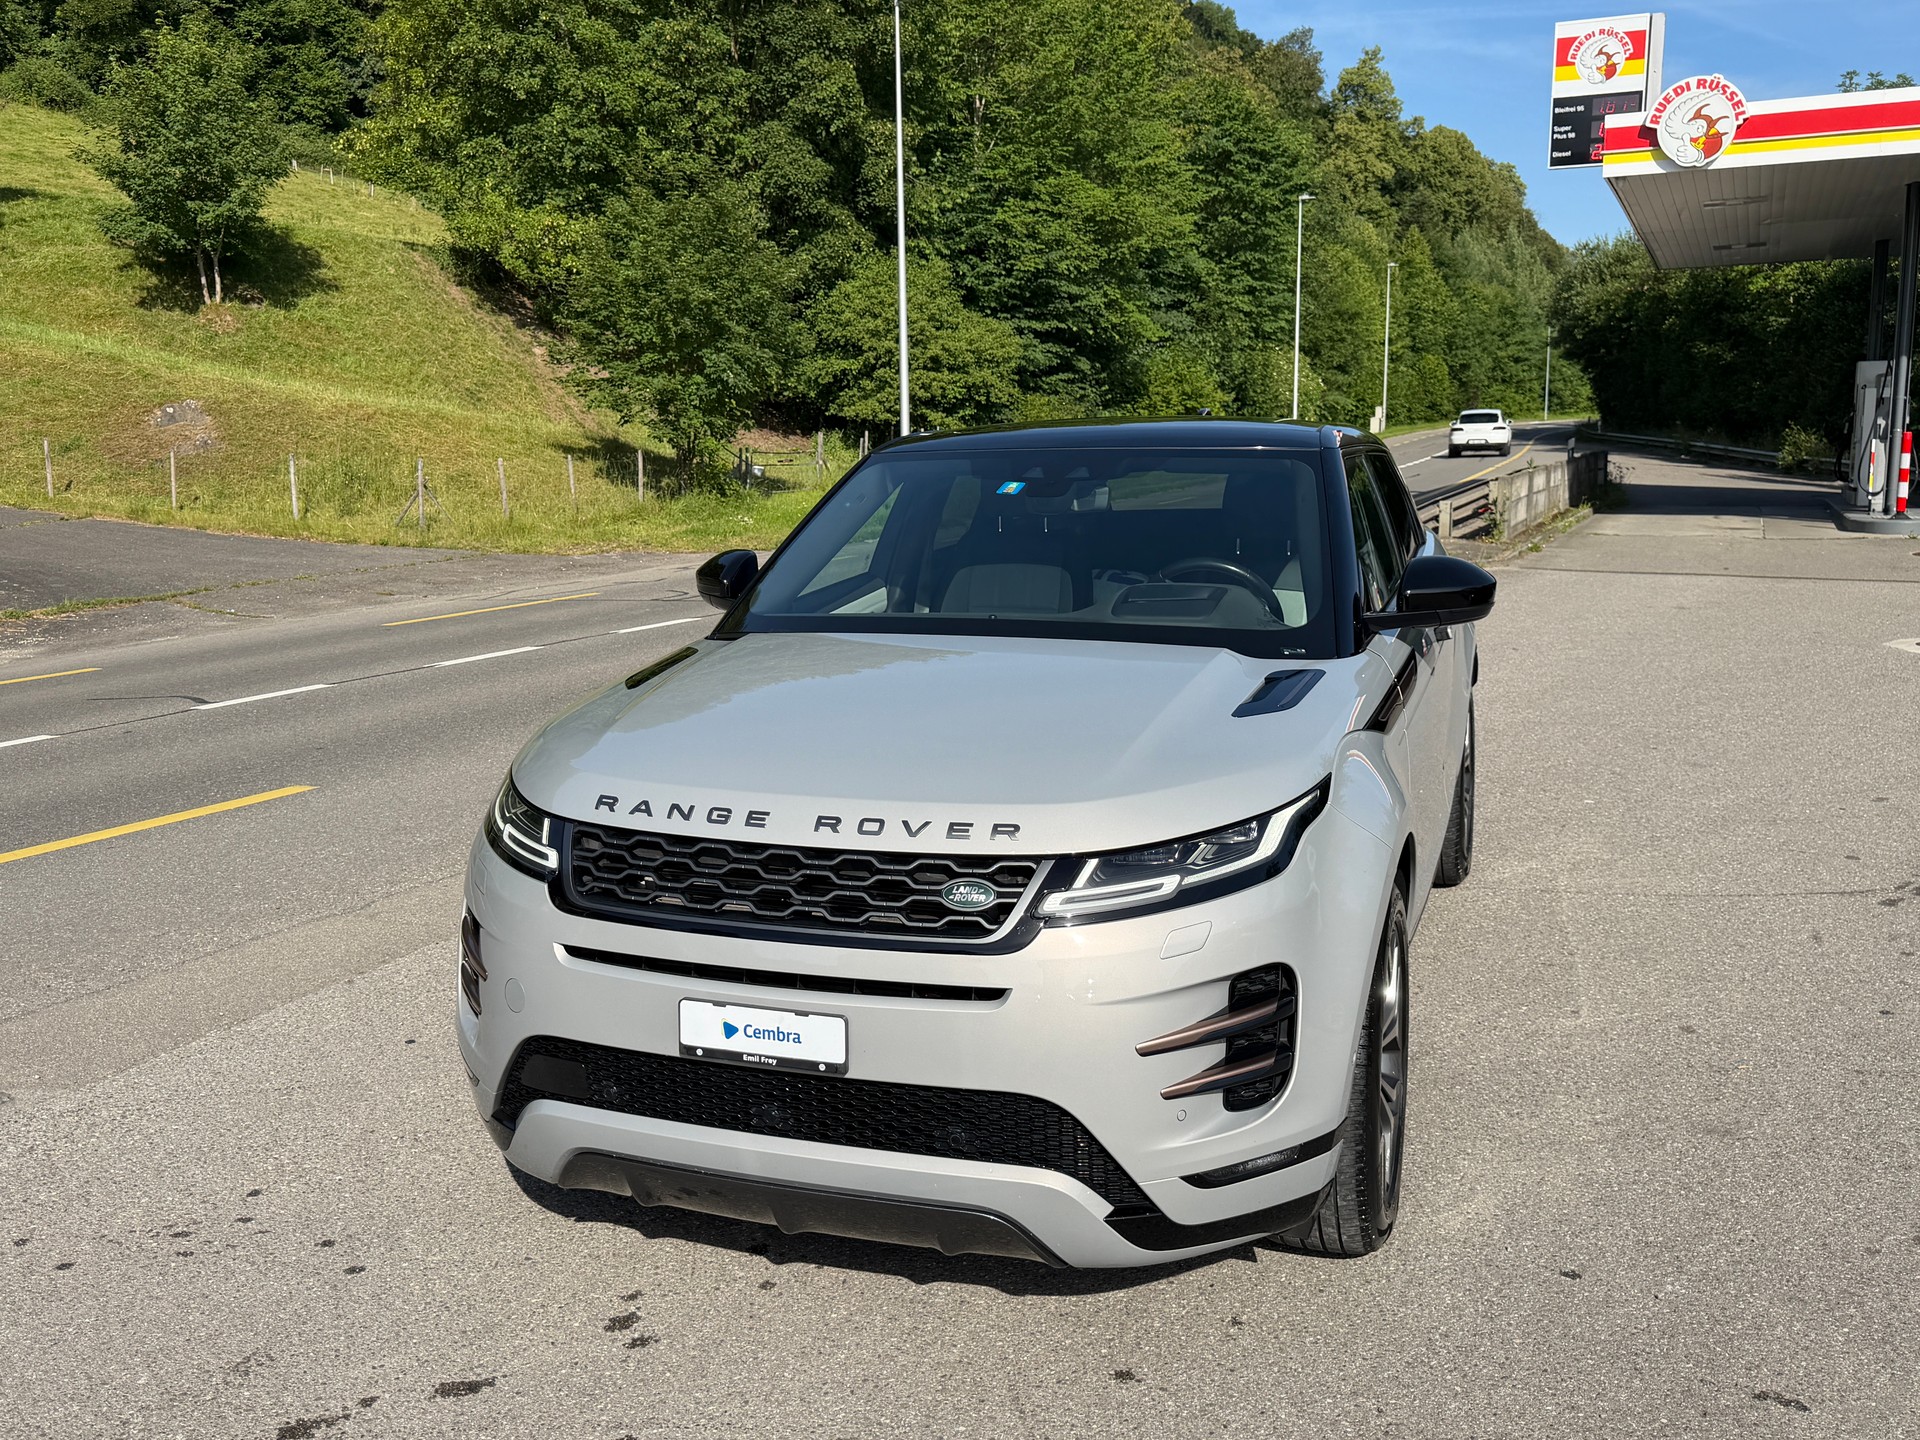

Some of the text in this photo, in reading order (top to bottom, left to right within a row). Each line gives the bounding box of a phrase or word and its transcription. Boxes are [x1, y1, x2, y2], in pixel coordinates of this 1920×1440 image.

[1570, 26, 1631, 60] RUEDI RÜSSEL
[1649, 75, 1747, 125] RUEDI RÜSSEL
[1553, 125, 1572, 133] Super
[1552, 150, 1572, 158] Diesel
[595, 794, 1021, 841] RANGE ROVER
[952, 885, 978, 894] LAND
[953, 893, 986, 902] ROVER
[743, 1024, 802, 1044] Cembra
[743, 1054, 777, 1066] Emil Frey
